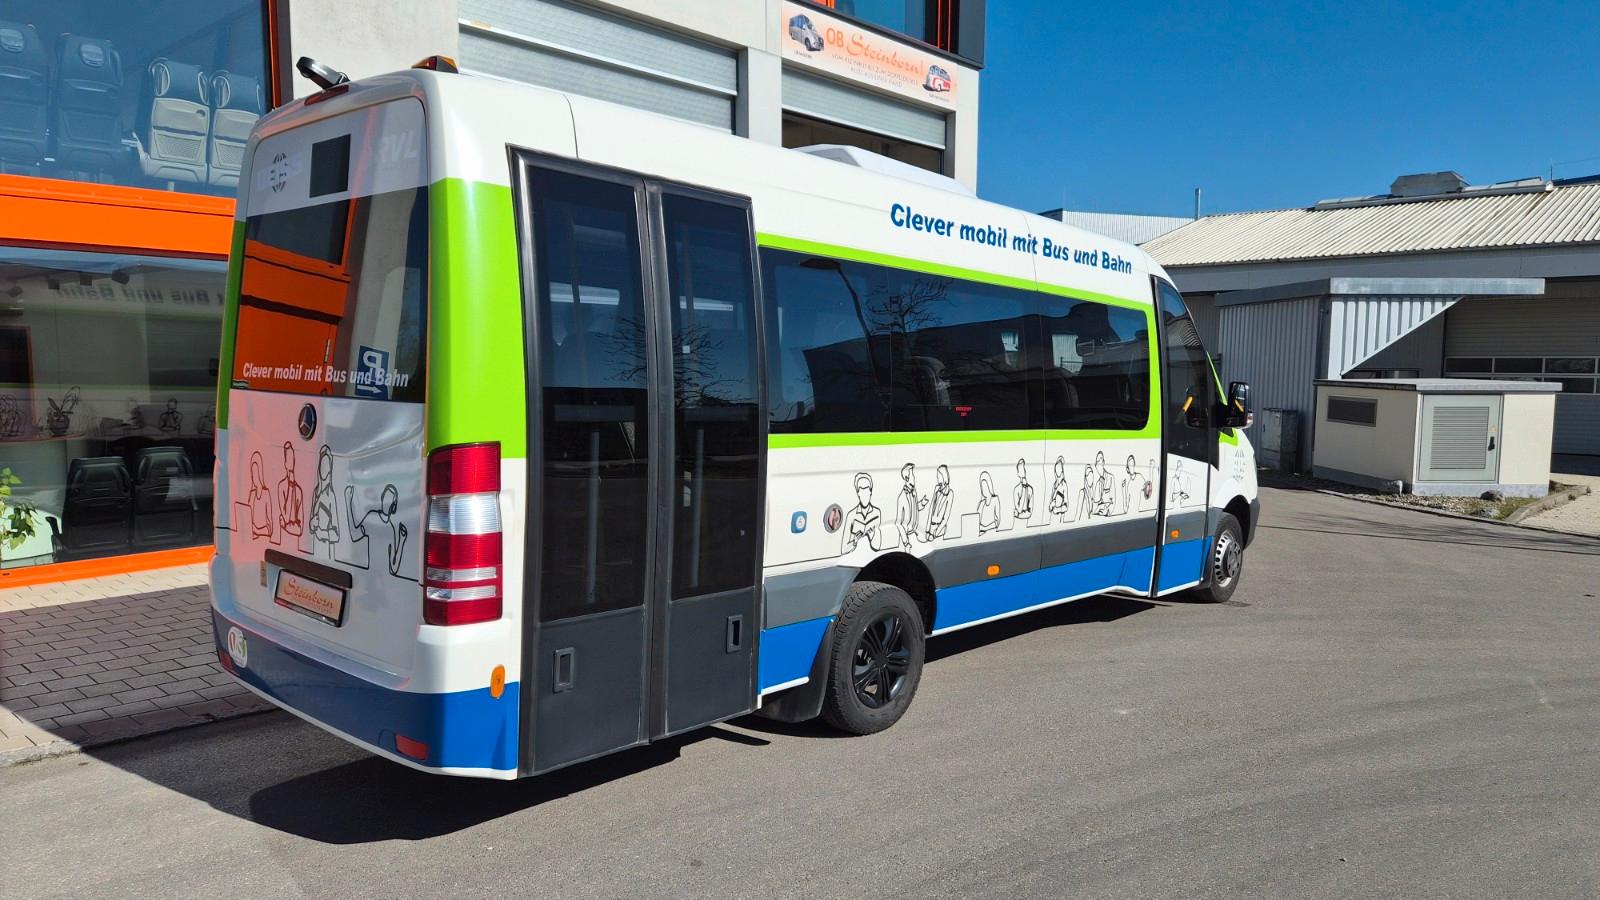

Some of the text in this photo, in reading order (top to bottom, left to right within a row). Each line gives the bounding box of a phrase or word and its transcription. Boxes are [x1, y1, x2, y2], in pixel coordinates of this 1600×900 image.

[826, 27, 844, 48] OB
[890, 203, 1132, 274] Clever mobil mit Bus und Bahn
[242, 362, 409, 388] Clever mobil mit Bus und Bahn
